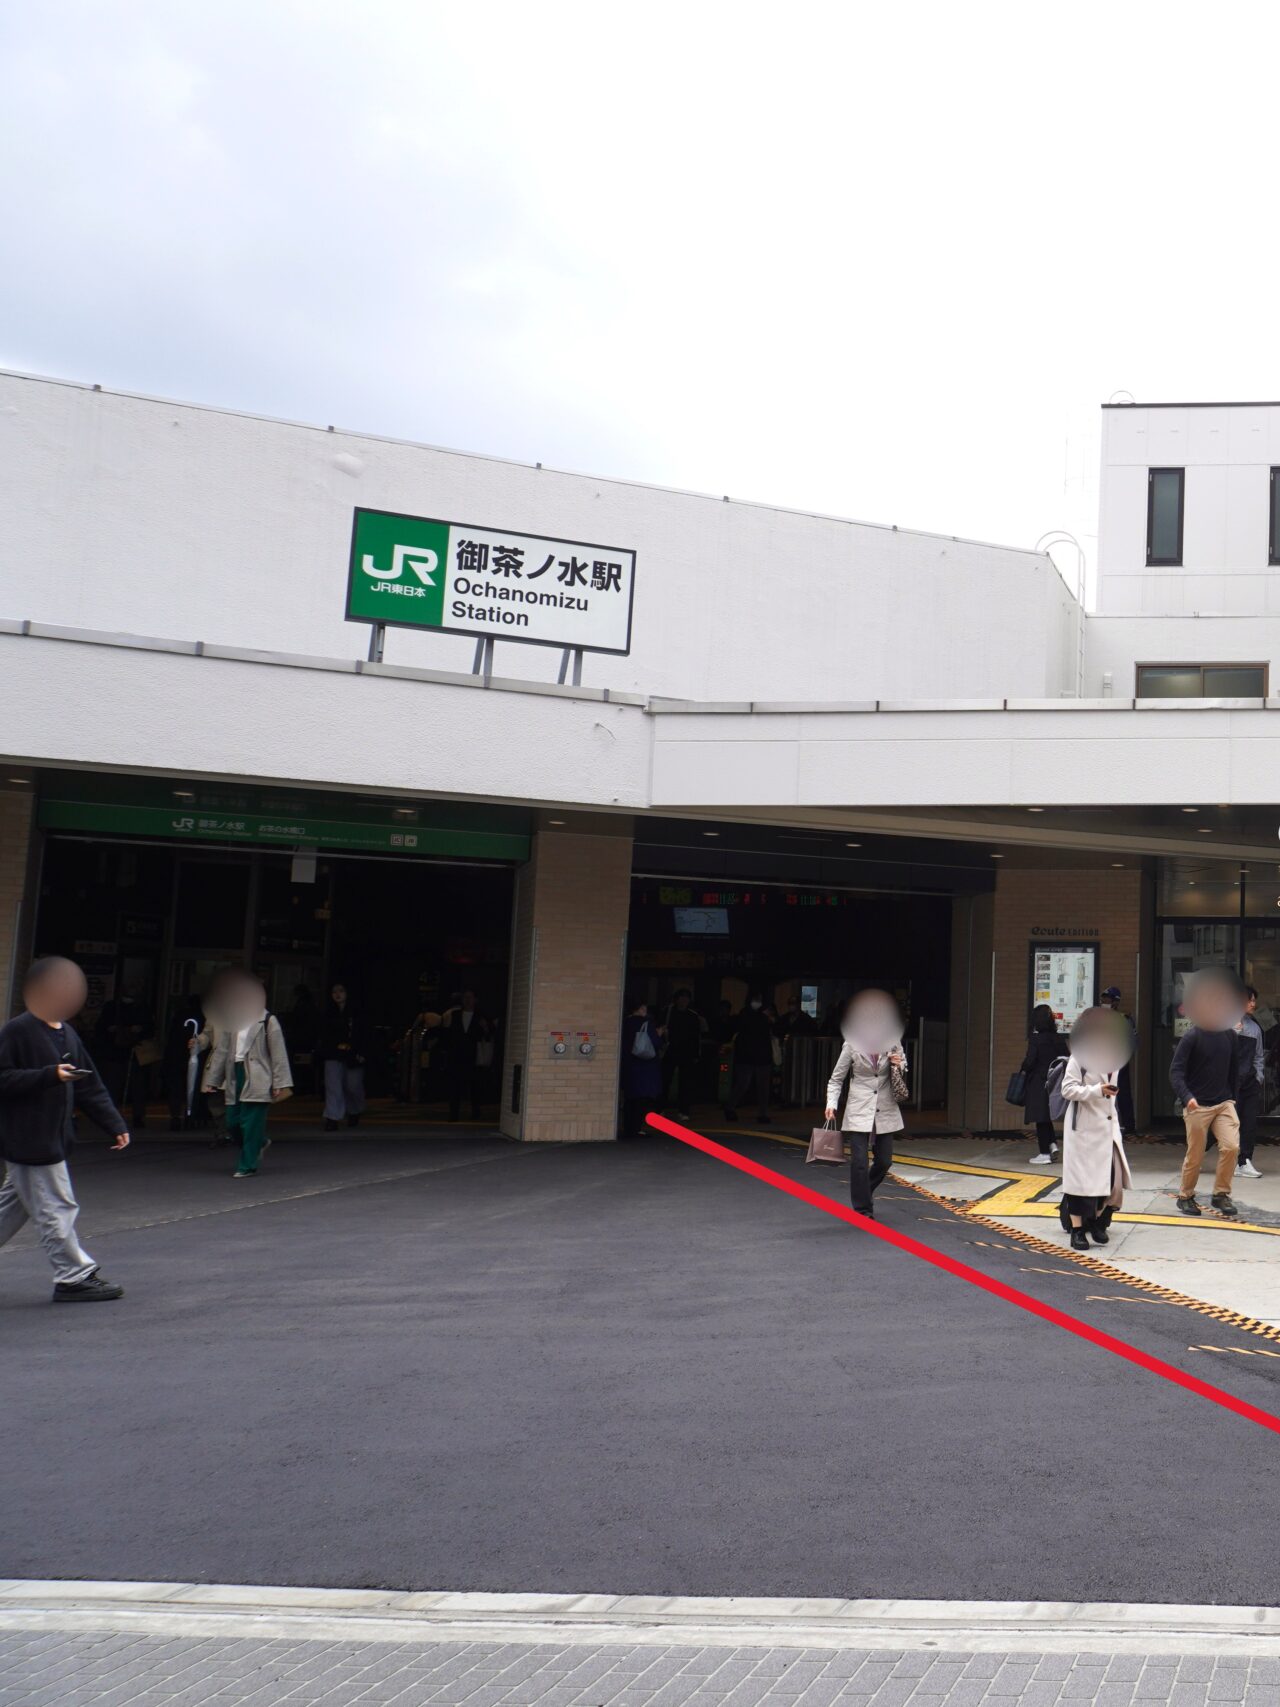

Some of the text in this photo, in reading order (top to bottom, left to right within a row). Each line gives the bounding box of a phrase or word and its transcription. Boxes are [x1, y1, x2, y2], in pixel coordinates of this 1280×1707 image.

[362, 543, 439, 586] JR
[456, 539, 623, 593] 御茶ノ水駅
[370, 581, 426, 598] JR東日本
[453, 577, 588, 612] Ochanomizu
[452, 601, 529, 626] Station
[172, 817, 195, 830] JR
